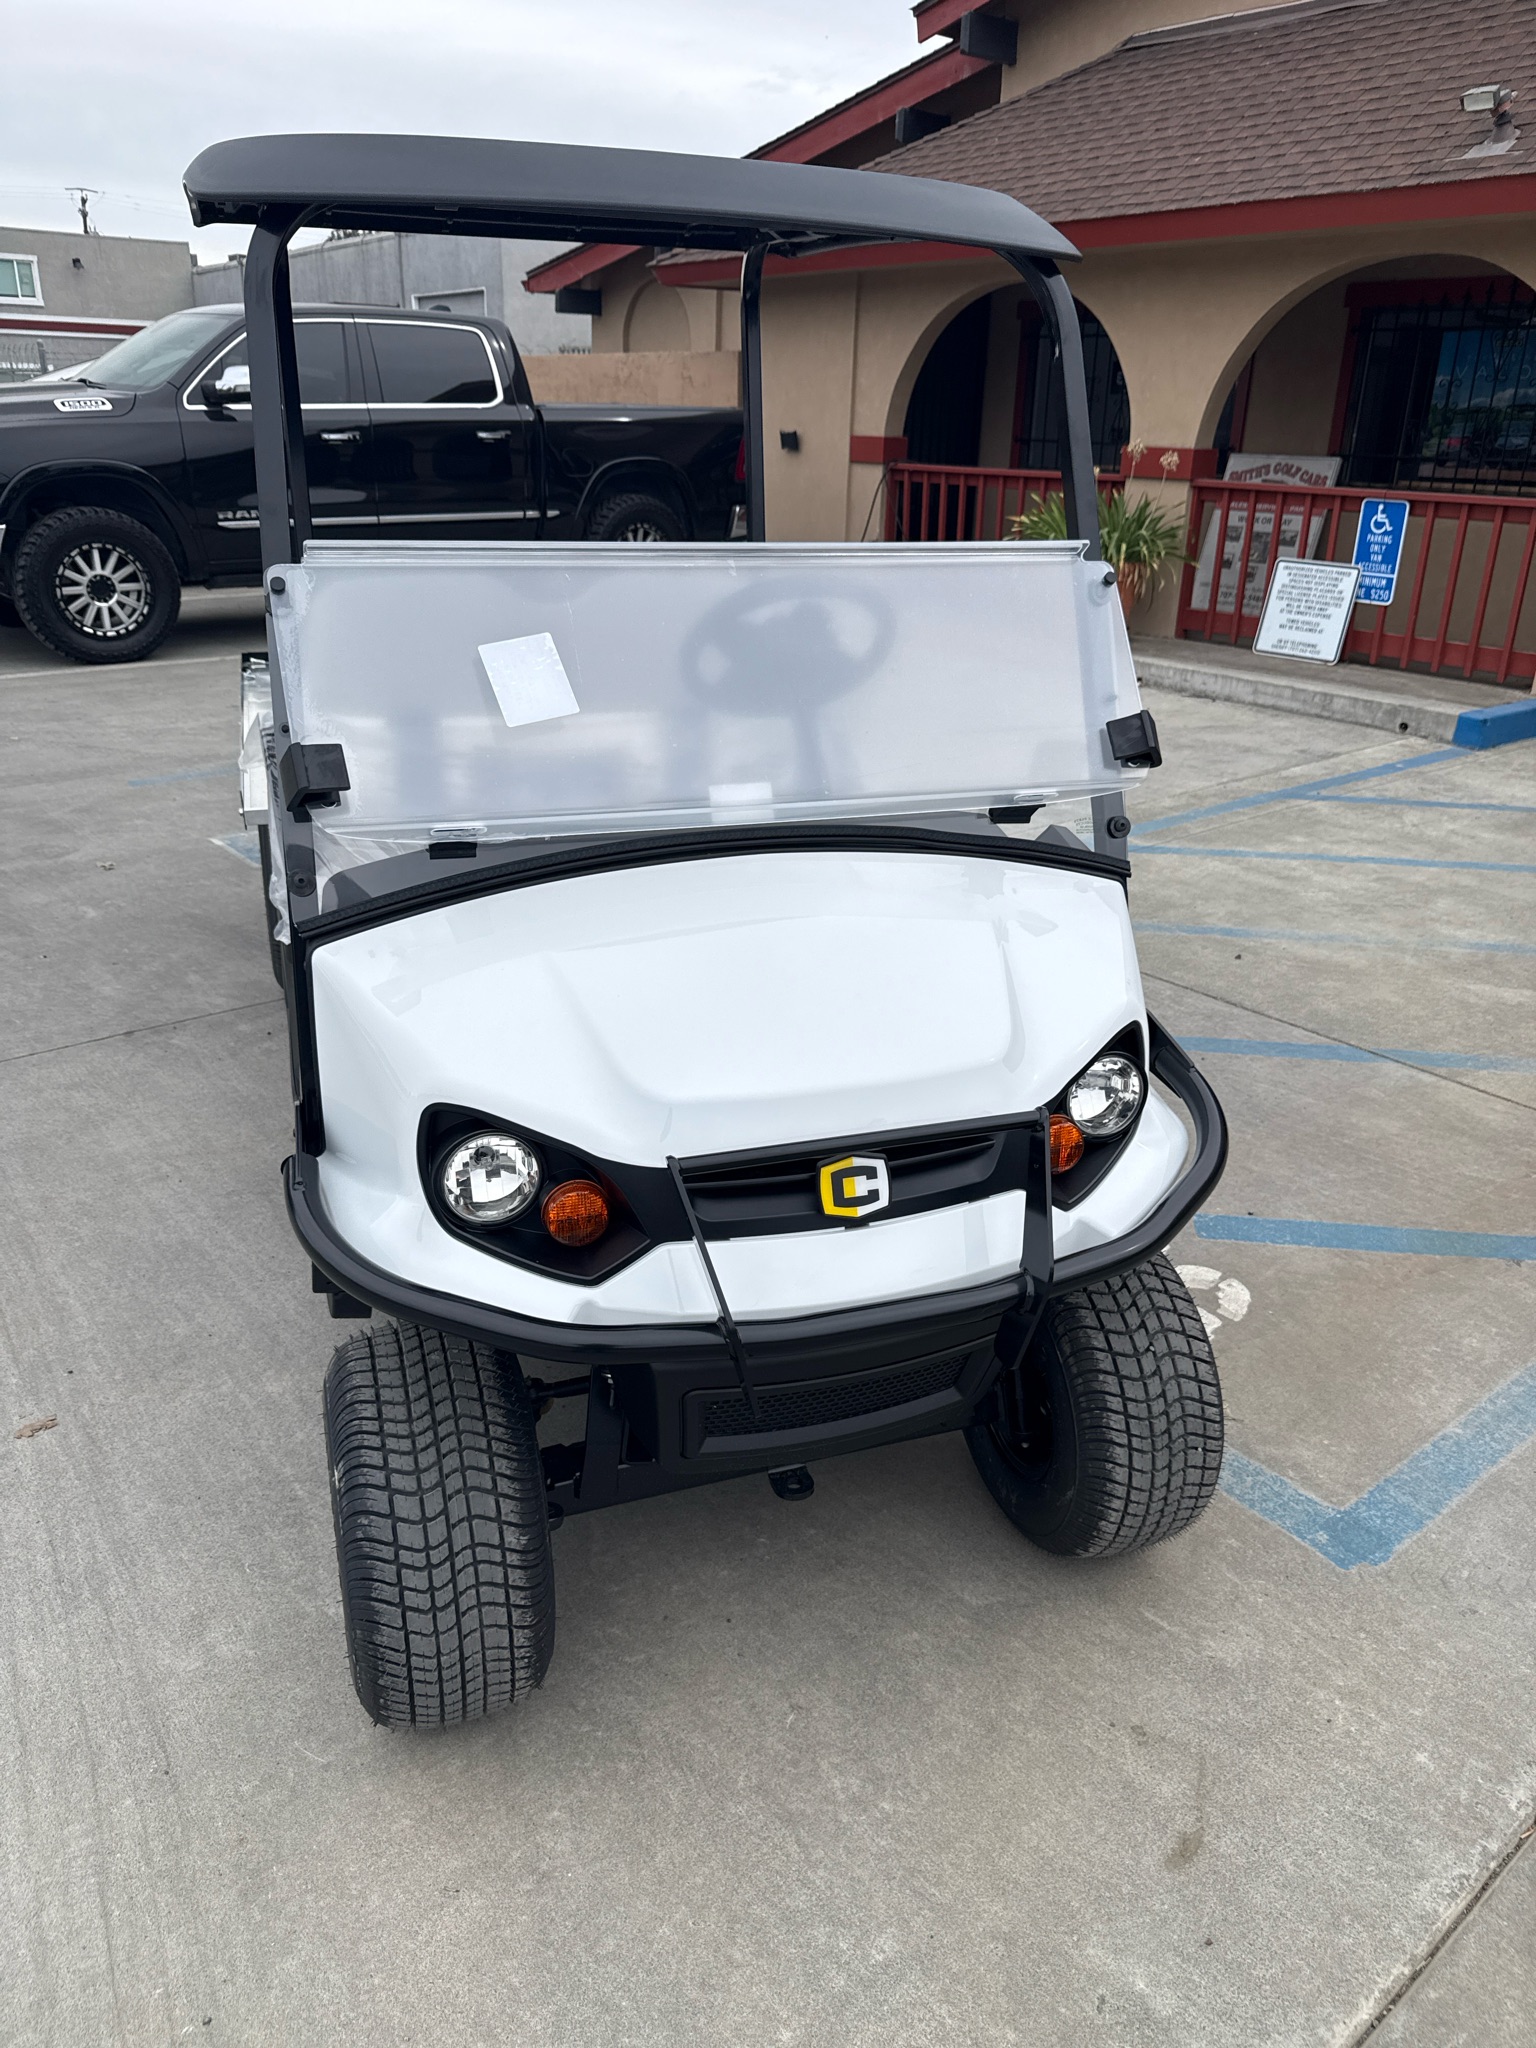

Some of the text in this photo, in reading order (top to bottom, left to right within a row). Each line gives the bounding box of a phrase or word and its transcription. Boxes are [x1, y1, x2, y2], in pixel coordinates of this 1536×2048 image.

[1228, 462, 1328, 487] SMITH'S GOLF CARS
[1366, 533, 1393, 545] PARKING
[1369, 543, 1387, 553] ONLY
[1370, 553, 1383, 563] VAN
[1370, 588, 1390, 601] $250
